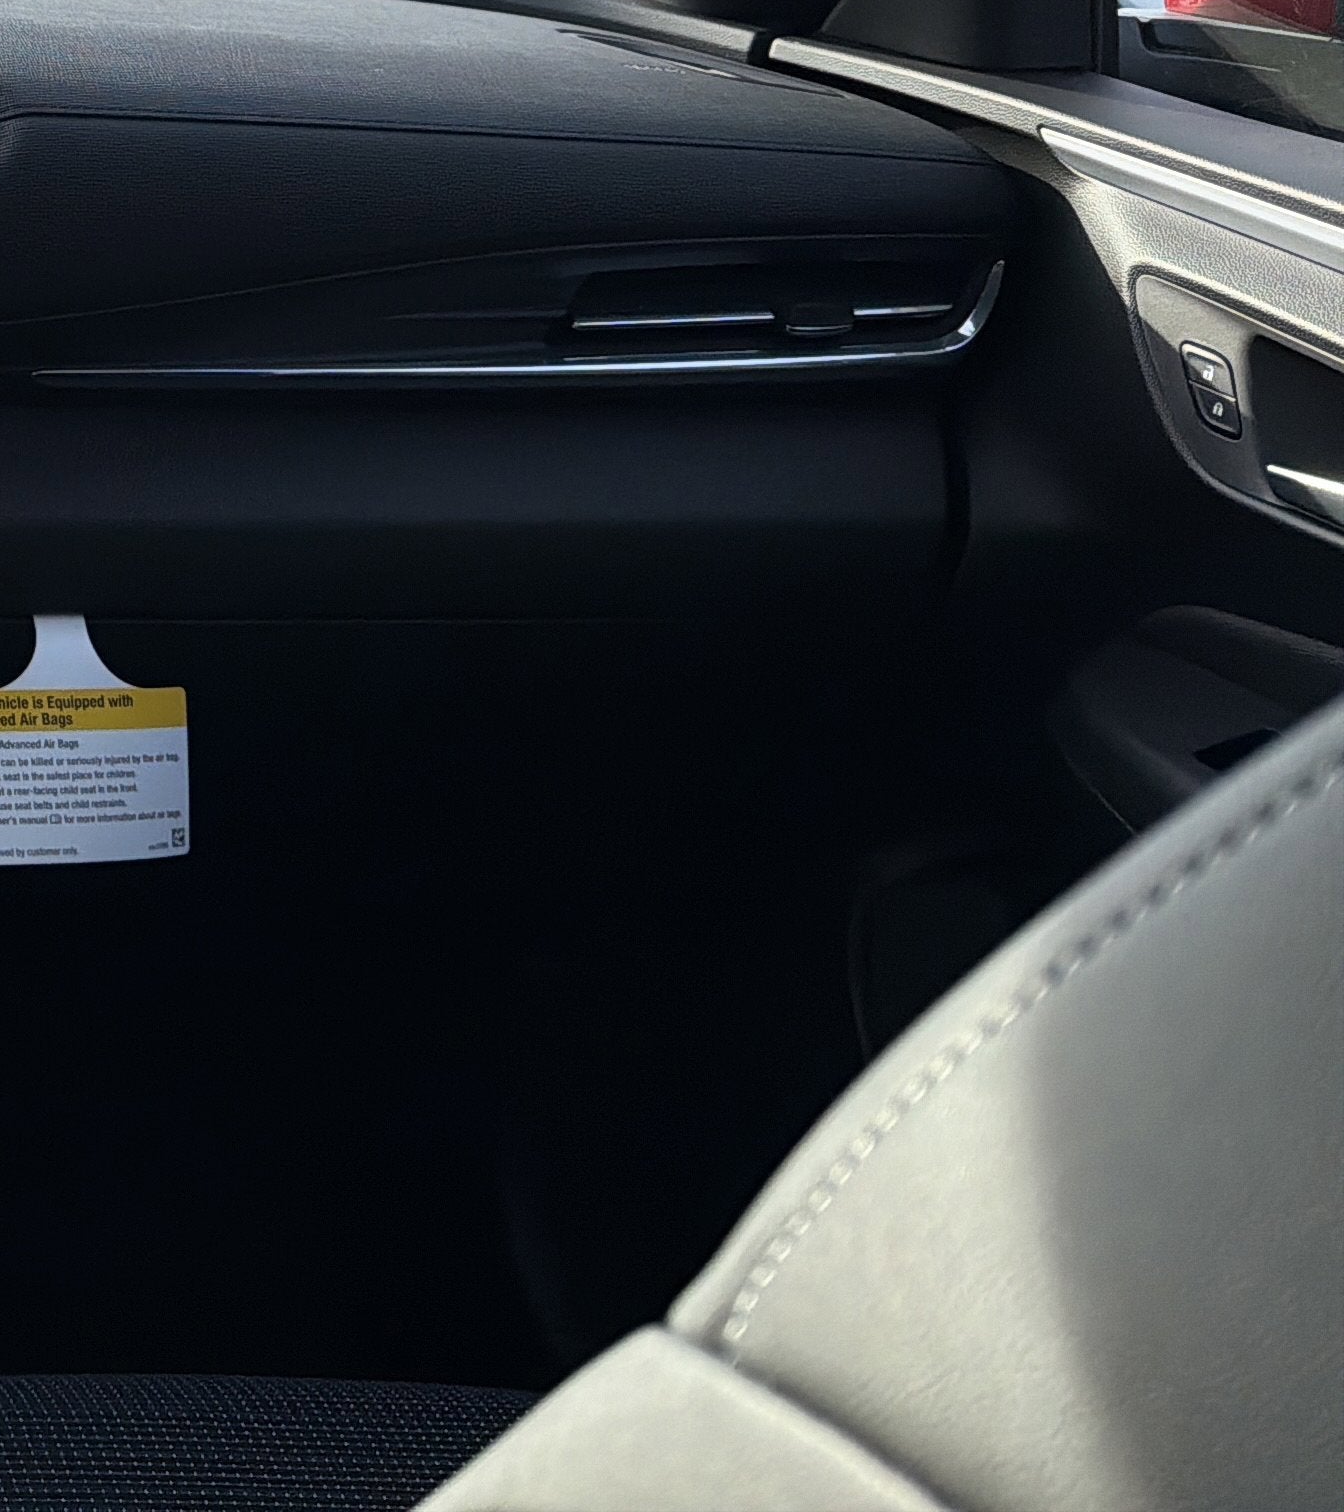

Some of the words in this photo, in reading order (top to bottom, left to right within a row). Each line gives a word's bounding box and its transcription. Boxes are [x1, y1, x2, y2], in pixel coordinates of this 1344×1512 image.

[32, 696, 43, 708] is
[48, 696, 105, 711] Equipped
[108, 694, 133, 706] with
[20, 713, 37, 725] Air
[43, 712, 73, 727] Bags
[0, 740, 41, 749] Advanced
[43, 740, 55, 748] Air
[58, 740, 79, 749] Bags
[16, 848, 25, 858] by
[27, 847, 60, 856] customer
